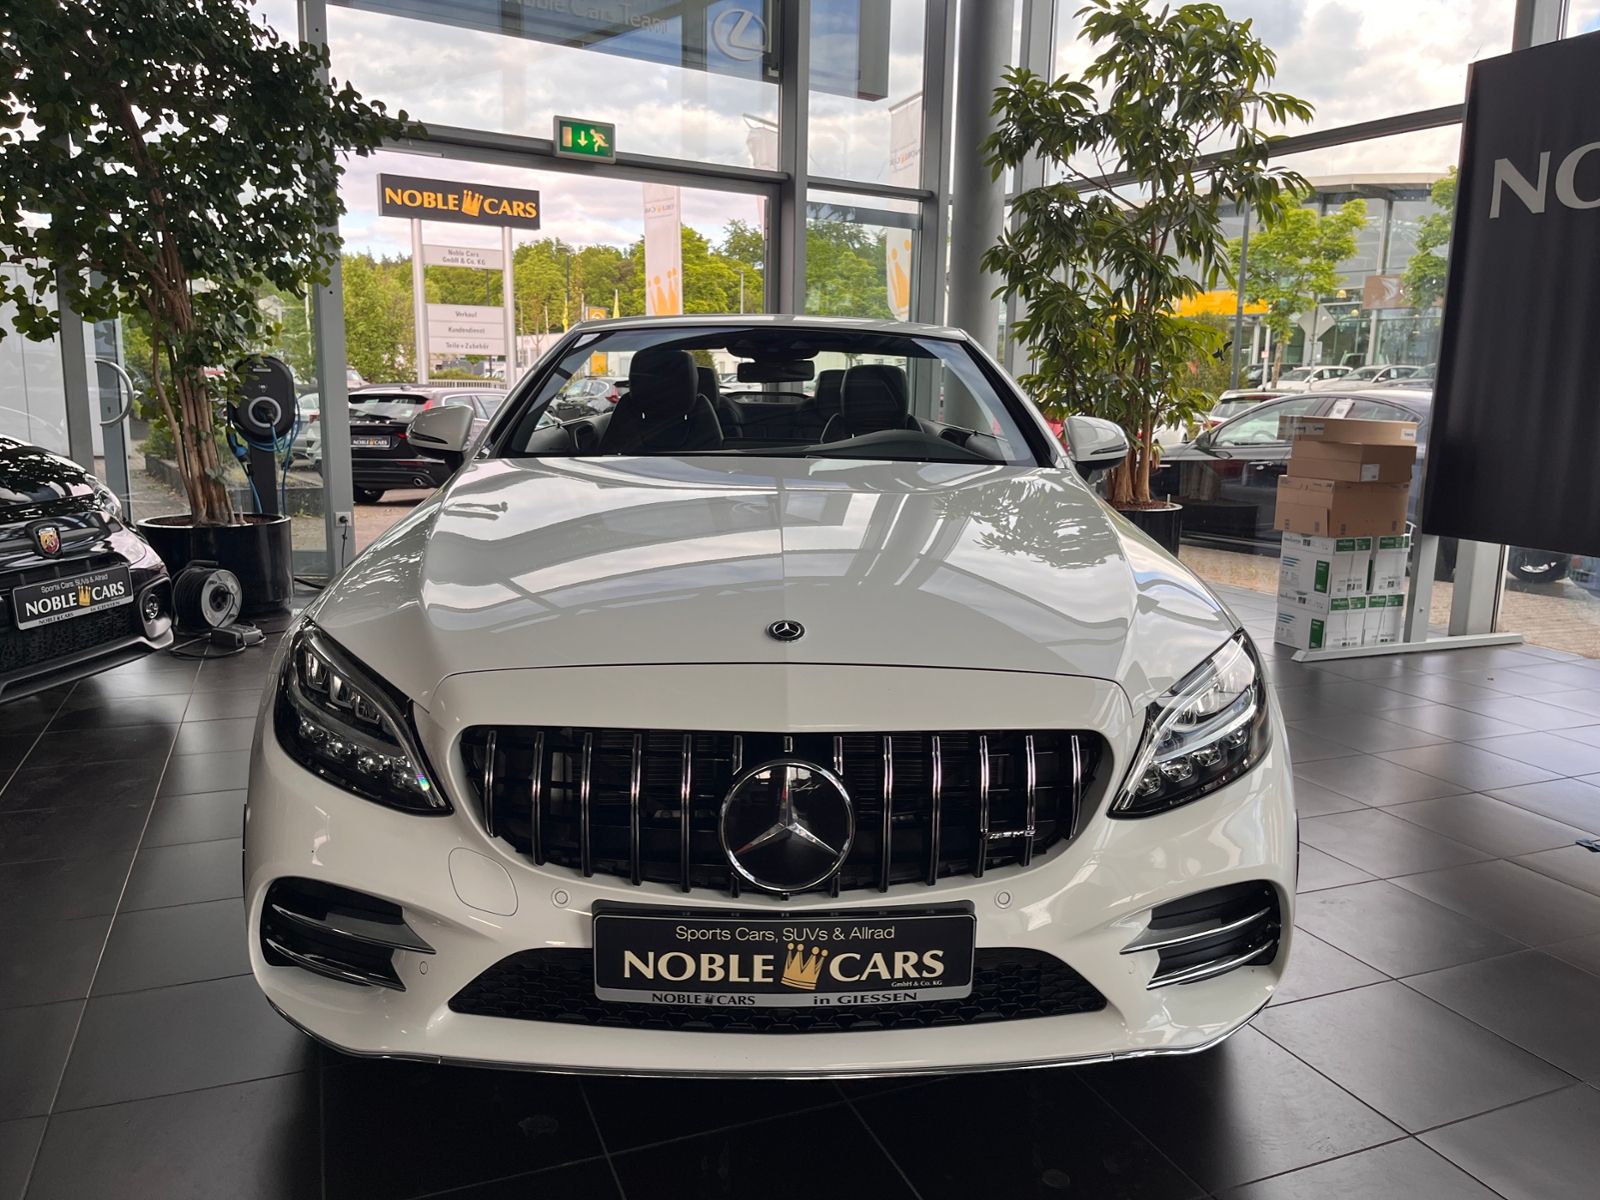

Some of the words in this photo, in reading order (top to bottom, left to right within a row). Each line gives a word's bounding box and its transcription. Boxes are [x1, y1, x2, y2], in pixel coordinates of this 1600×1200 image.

[619, 3, 667, 33] Team
[385, 187, 459, 211] NOBLE
[483, 198, 538, 218] CARS
[442, 256, 459, 264] GmbH
[41, 583, 60, 594] Sports
[75, 577, 90, 586] SUVs
[94, 573, 108, 582] Allrad
[25, 592, 77, 617] NOBLE
[92, 581, 125, 601] CARS
[675, 925, 731, 942] Sports
[735, 927, 778, 943] Cars,
[782, 927, 829, 941] SUVs
[832, 927, 845, 941] &
[849, 926, 896, 940] Allrad
[623, 950, 775, 982] NOBLE
[829, 949, 945, 982] CARS
[891, 980, 913, 988] GmbH
[652, 993, 701, 1005] NOBLE
[716, 995, 756, 1005] CARS
[813, 996, 831, 1005] in
[836, 992, 918, 1004] GIESSEN
